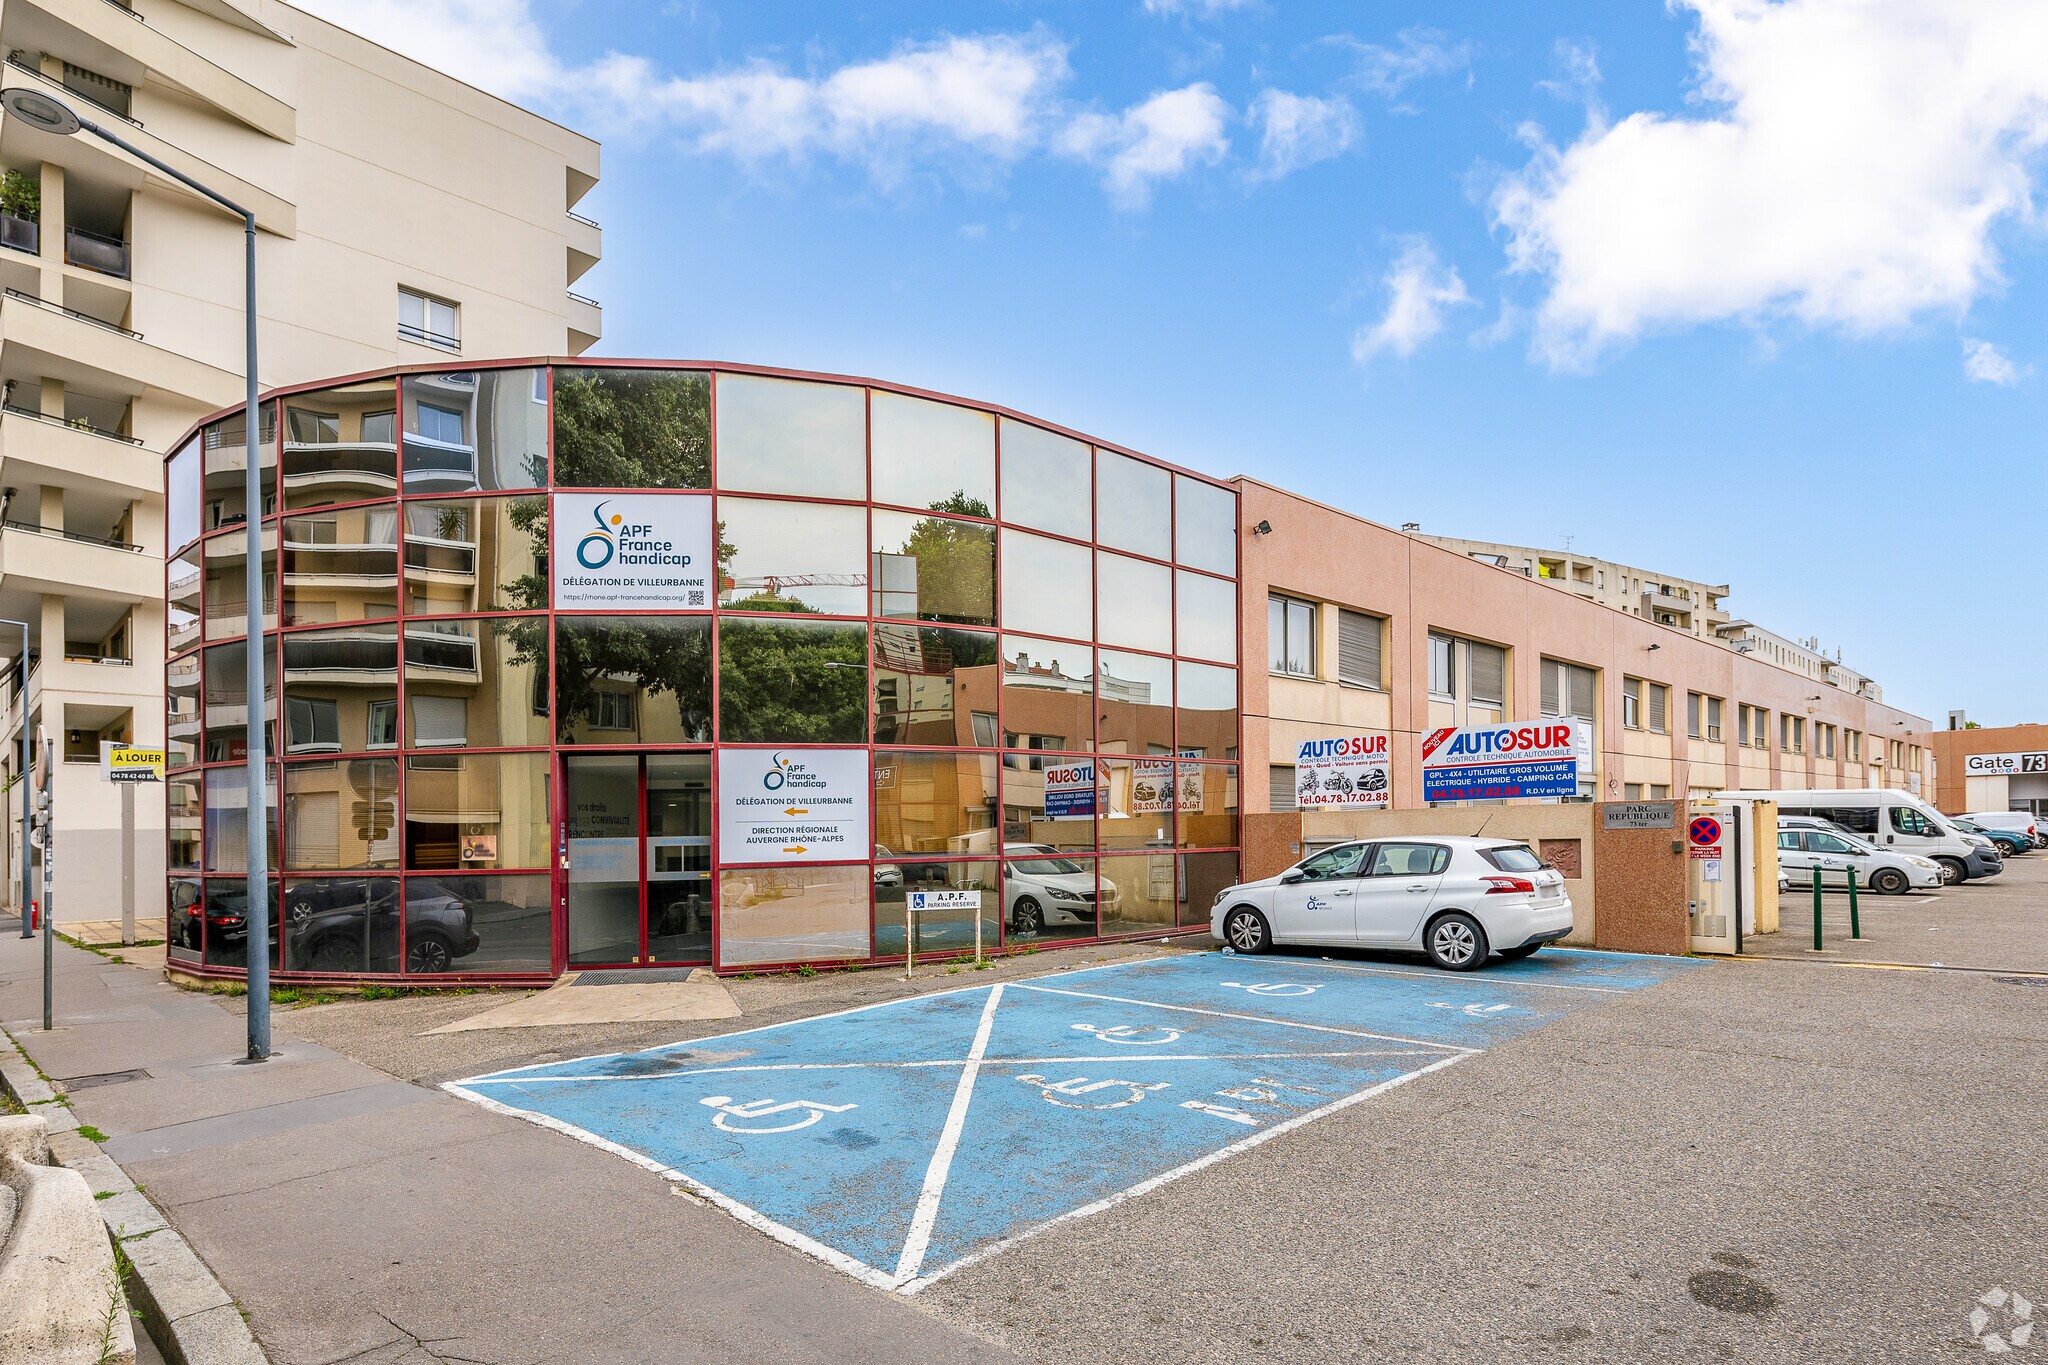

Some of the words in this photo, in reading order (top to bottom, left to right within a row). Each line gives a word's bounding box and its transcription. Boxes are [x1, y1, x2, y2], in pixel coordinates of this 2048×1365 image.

[620, 525, 652, 537] APF
[619, 539, 672, 551] France
[619, 552, 691, 568] handicap
[563, 576, 621, 586] DÉLÉGATION
[638, 578, 704, 586] VILLEURBANNE
[1423, 730, 1444, 750] NOUVEAU
[1446, 725, 1571, 755] AUTOSUR
[1299, 736, 1387, 758] AUTOSUR
[116, 751, 123, 761] À
[126, 754, 161, 762] LOUER
[1446, 755, 1481, 763] CONTROLE
[1483, 752, 1522, 761] TECHNIQUE
[1524, 749, 1571, 759] AUTOMOBILE
[1969, 756, 2013, 769] Gate
[2024, 755, 2046, 771] 73
[1468, 768, 1507, 777] UTILITAIRE
[1510, 766, 1532, 774] GROS
[1534, 764, 1568, 772] VOLUME
[787, 780, 827, 789] handicap
[1427, 779, 1472, 787] ELECTRIQUE
[1478, 776, 1511, 785] HYBRIDE
[1517, 774, 1554, 783] CAMPING
[1432, 786, 1520, 798] 04.78.17.02.88
[1557, 787, 1574, 795] ligne
[736, 797, 785, 805] DÉLÉGATION
[1299, 792, 1388, 804] Tél.04.78.17.02.88
[590, 802, 607, 812] droits
[591, 814, 630, 825] CONVIVIALITÉ
[1609, 812, 1670, 820] REPUBLIQUE
[796, 825, 838, 833] RÉGIONALE
